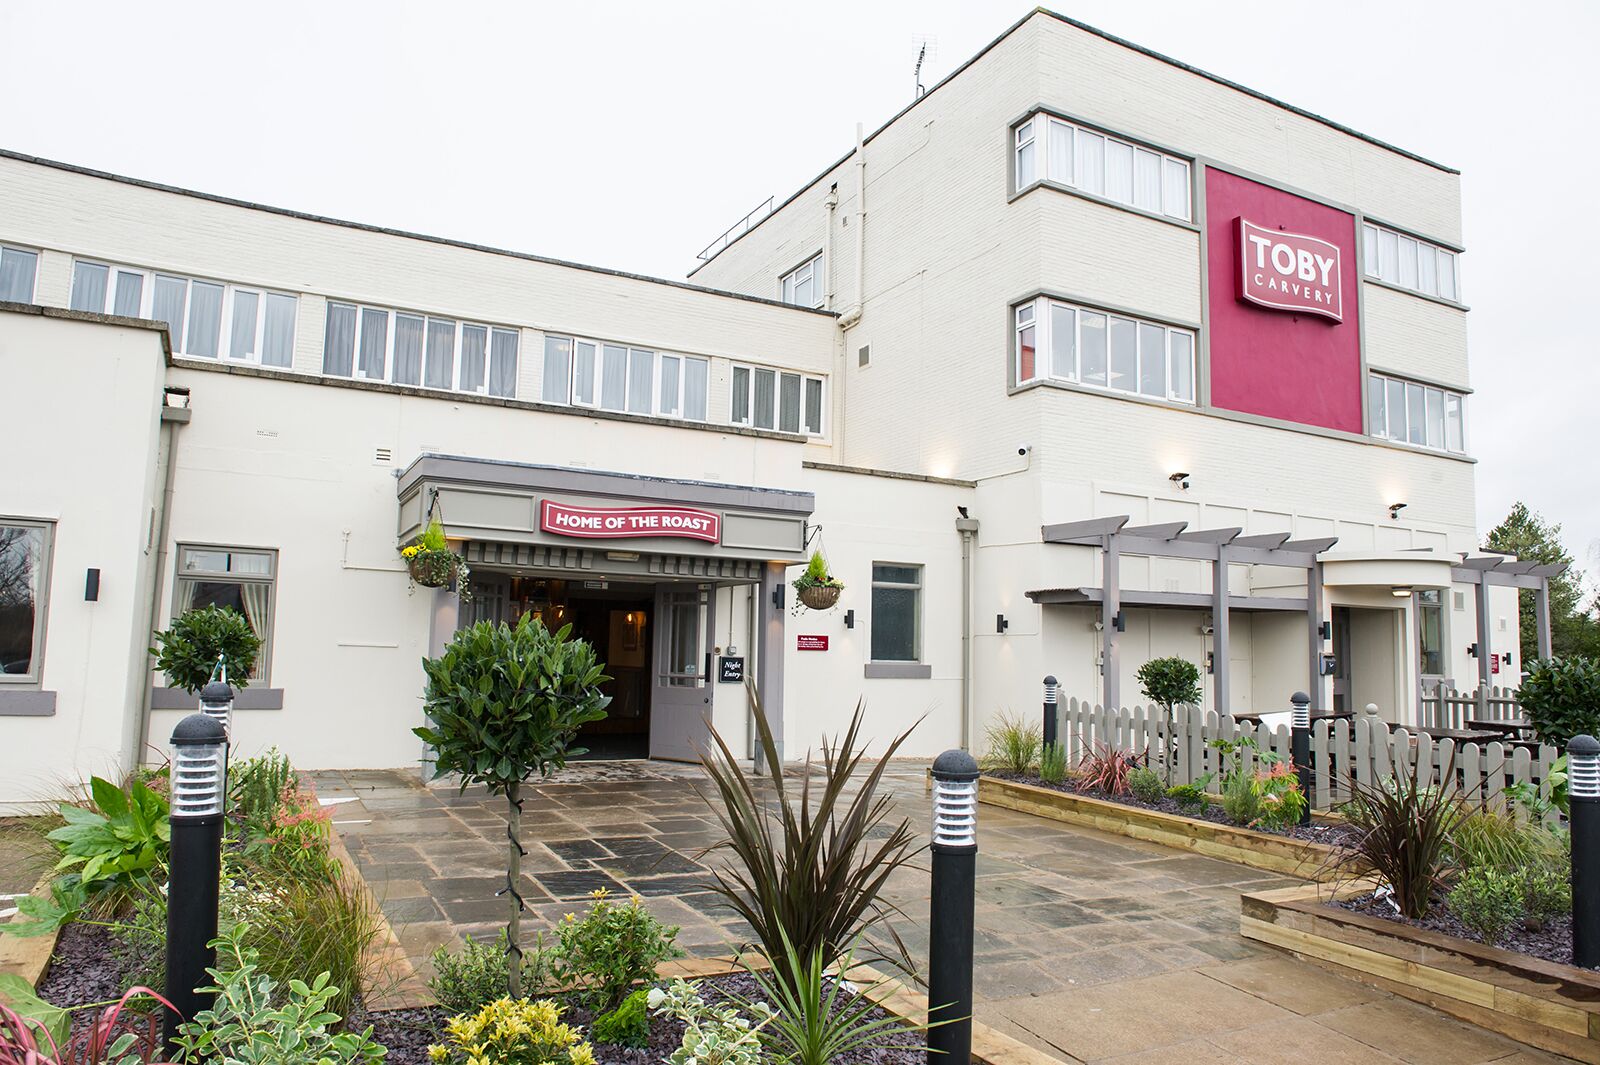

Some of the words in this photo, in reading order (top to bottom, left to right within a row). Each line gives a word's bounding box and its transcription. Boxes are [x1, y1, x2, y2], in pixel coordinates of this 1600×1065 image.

[1249, 234, 1335, 287] TOBY
[1254, 273, 1331, 305] CARVERY
[555, 512, 601, 529] HOME
[604, 517, 625, 529] OF
[628, 516, 659, 528] THE
[662, 515, 711, 531] ROAST
[724, 661, 741, 671] Night
[724, 670, 741, 679] Entry
